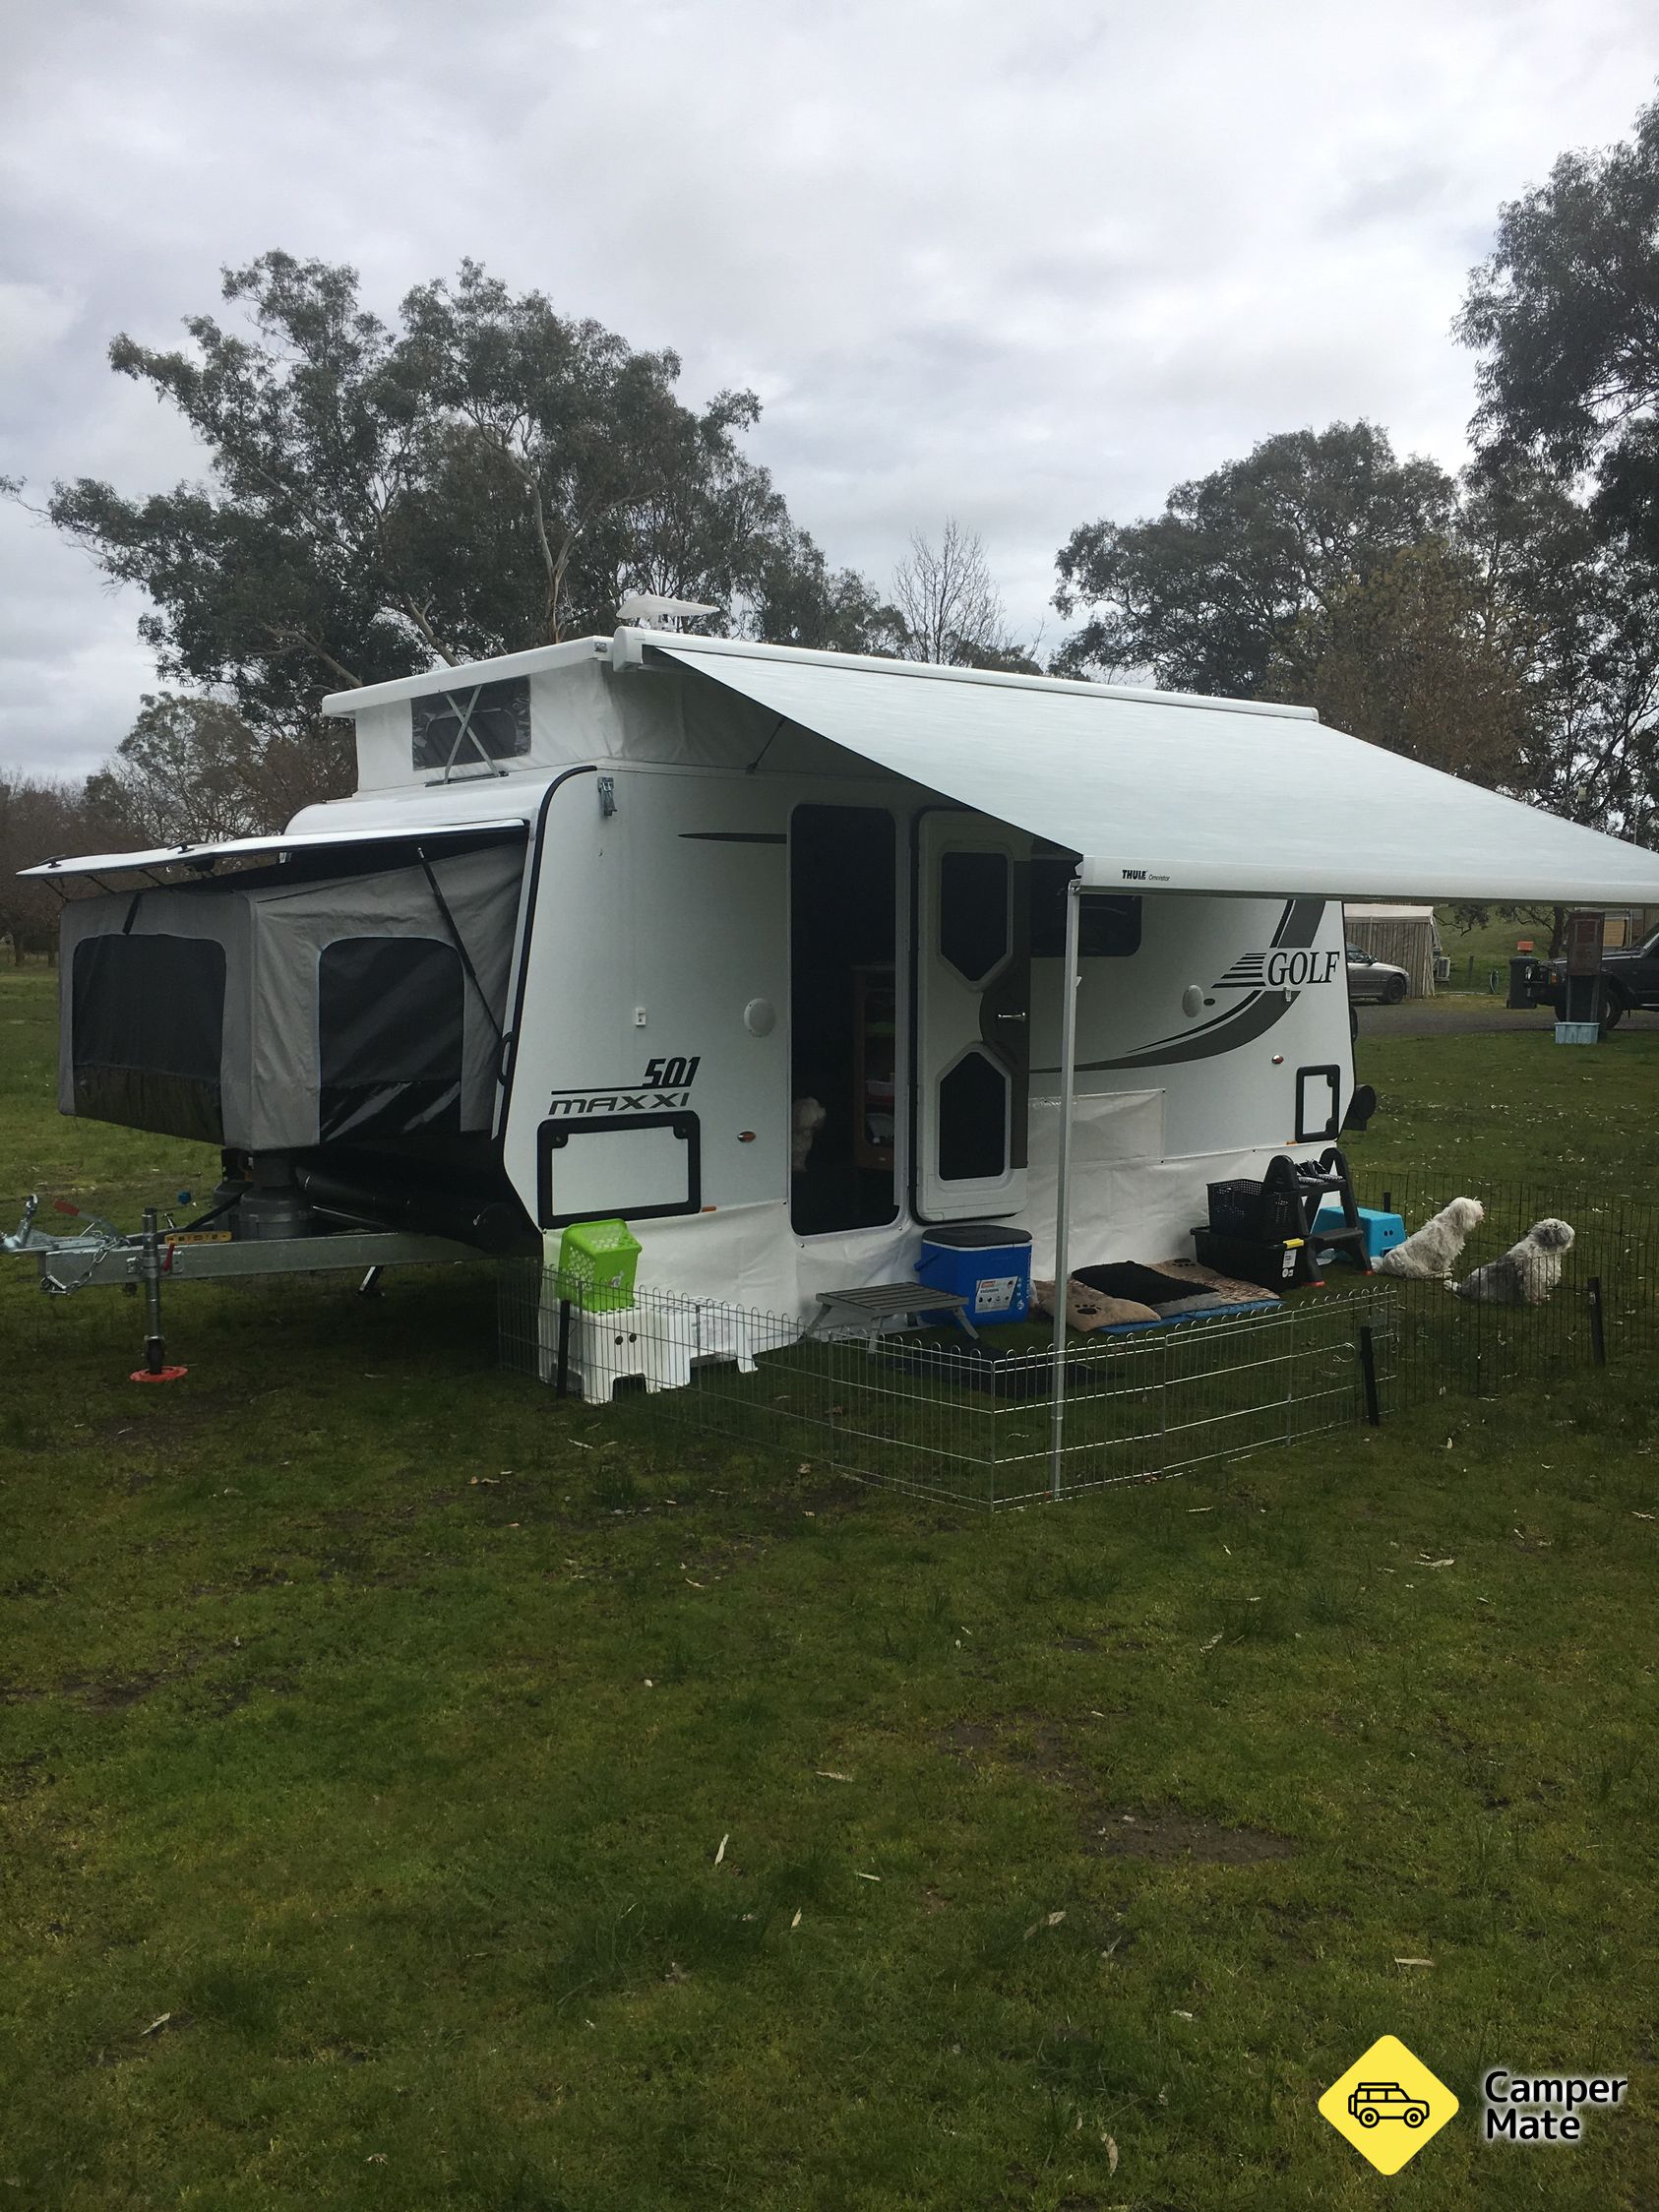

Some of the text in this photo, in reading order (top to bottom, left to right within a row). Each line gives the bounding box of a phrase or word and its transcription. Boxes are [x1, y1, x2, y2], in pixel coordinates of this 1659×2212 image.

[1122, 870, 1146, 880] THULE
[1267, 951, 1340, 986] GOLF
[642, 1056, 702, 1087] 501
